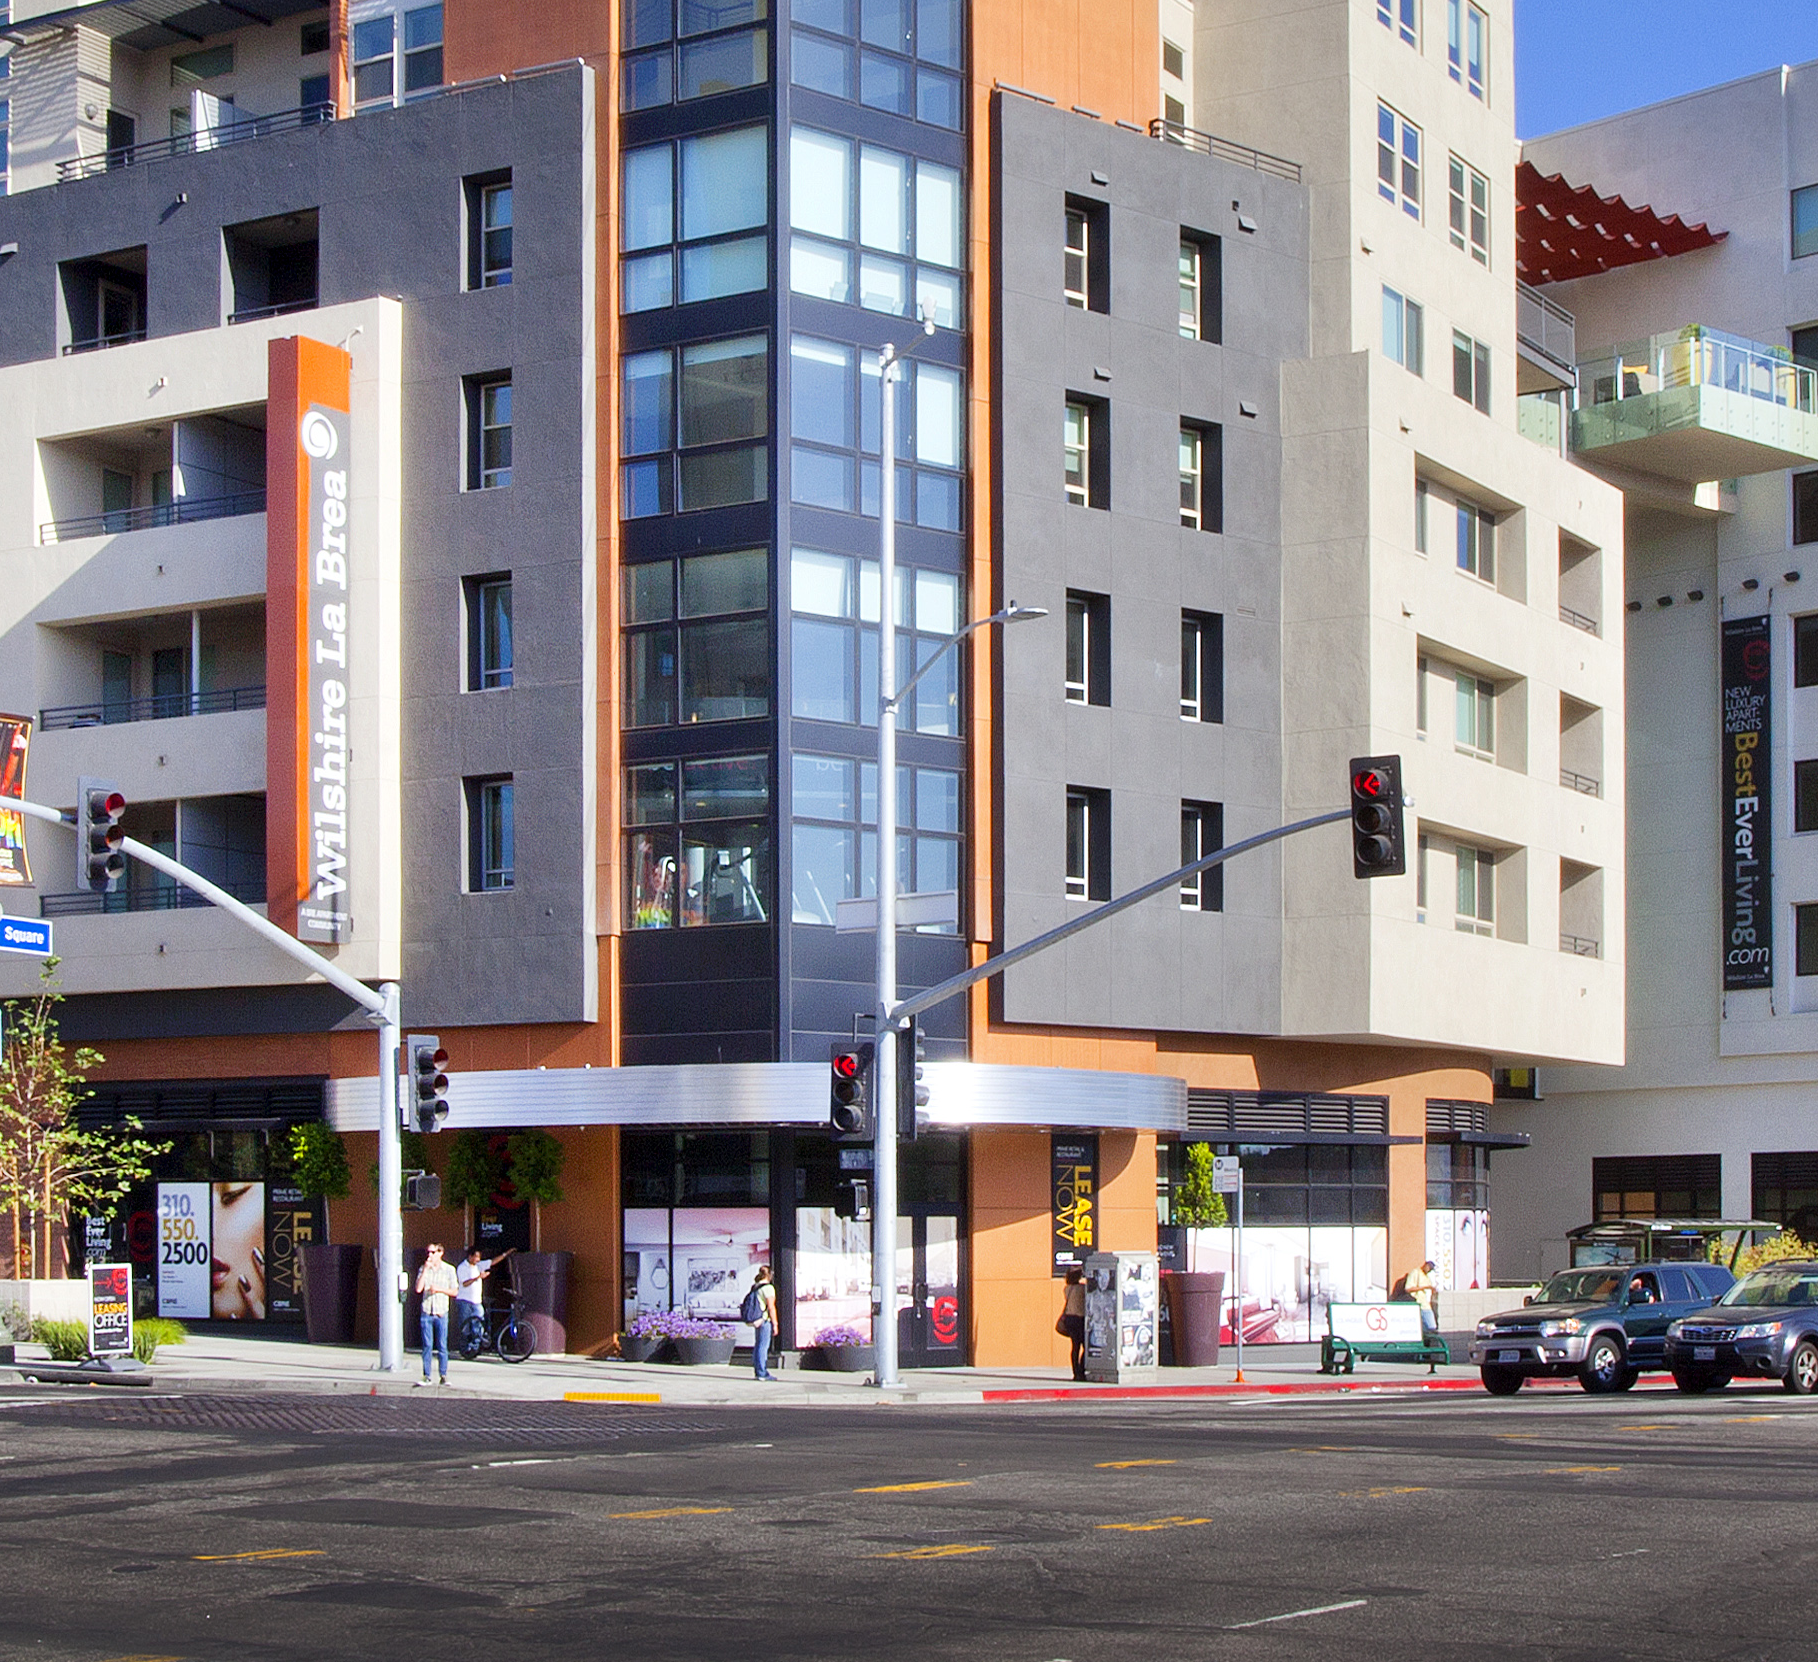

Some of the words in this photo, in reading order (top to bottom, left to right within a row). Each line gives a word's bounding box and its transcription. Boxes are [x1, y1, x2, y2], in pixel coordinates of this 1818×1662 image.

[316, 470, 347, 590] Brea
[316, 603, 347, 668] La
[1725, 685, 1751, 698] NEW
[1726, 694, 1766, 711] LUXURY
[1726, 707, 1760, 720] APART-
[1725, 718, 1762, 733] MENTS
[313, 679, 347, 900] Wilshire
[4, 925, 45, 945] Square
[1726, 947, 1769, 966] .com
[162, 1194, 195, 1217] 310.
[1056, 1164, 1074, 1242] NOW
[1073, 1165, 1093, 1247] LEASE
[162, 1218, 199, 1241] 550.
[162, 1241, 208, 1266] 2500
[272, 1211, 292, 1288] NOW
[93, 1312, 128, 1329] OFFICE
